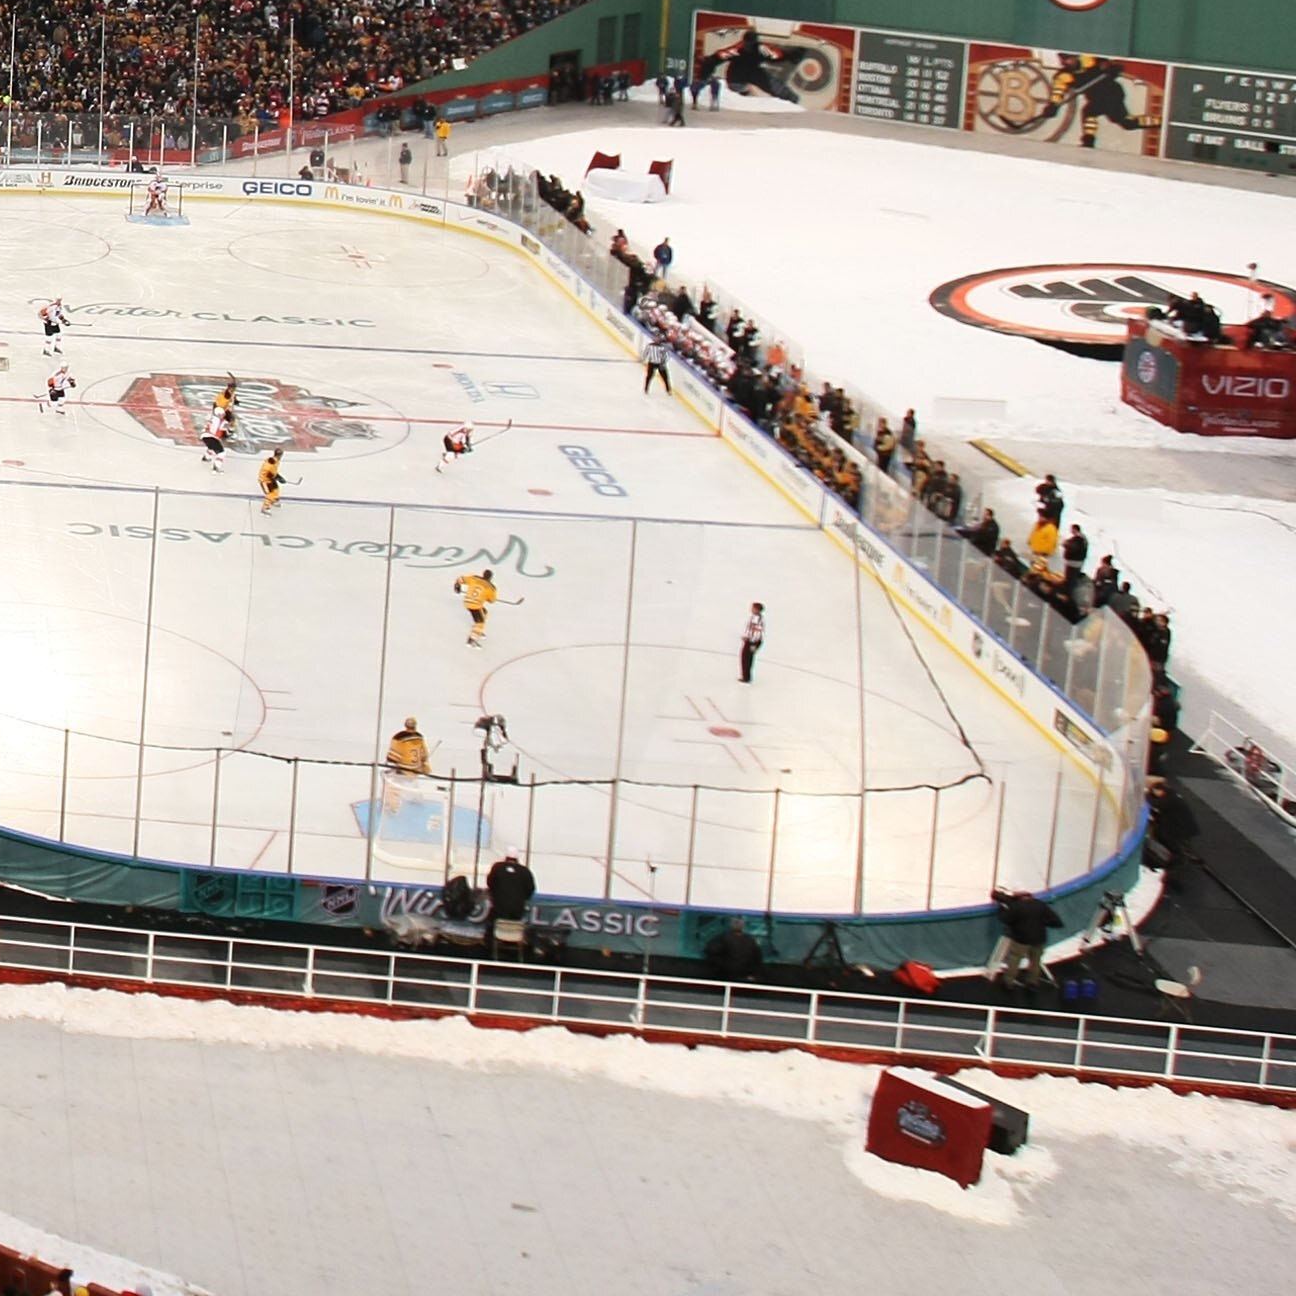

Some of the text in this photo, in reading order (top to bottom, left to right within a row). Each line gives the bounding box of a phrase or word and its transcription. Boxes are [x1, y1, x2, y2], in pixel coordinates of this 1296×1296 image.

[242, 181, 313, 197] GEICO
[192, 312, 376, 328] CLASSIC
[1201, 373, 1290, 399] VIZIO
[558, 445, 628, 497] GEICO
[68, 521, 555, 579] Winter CLASSIC
[525, 905, 661, 938] LASSIC
